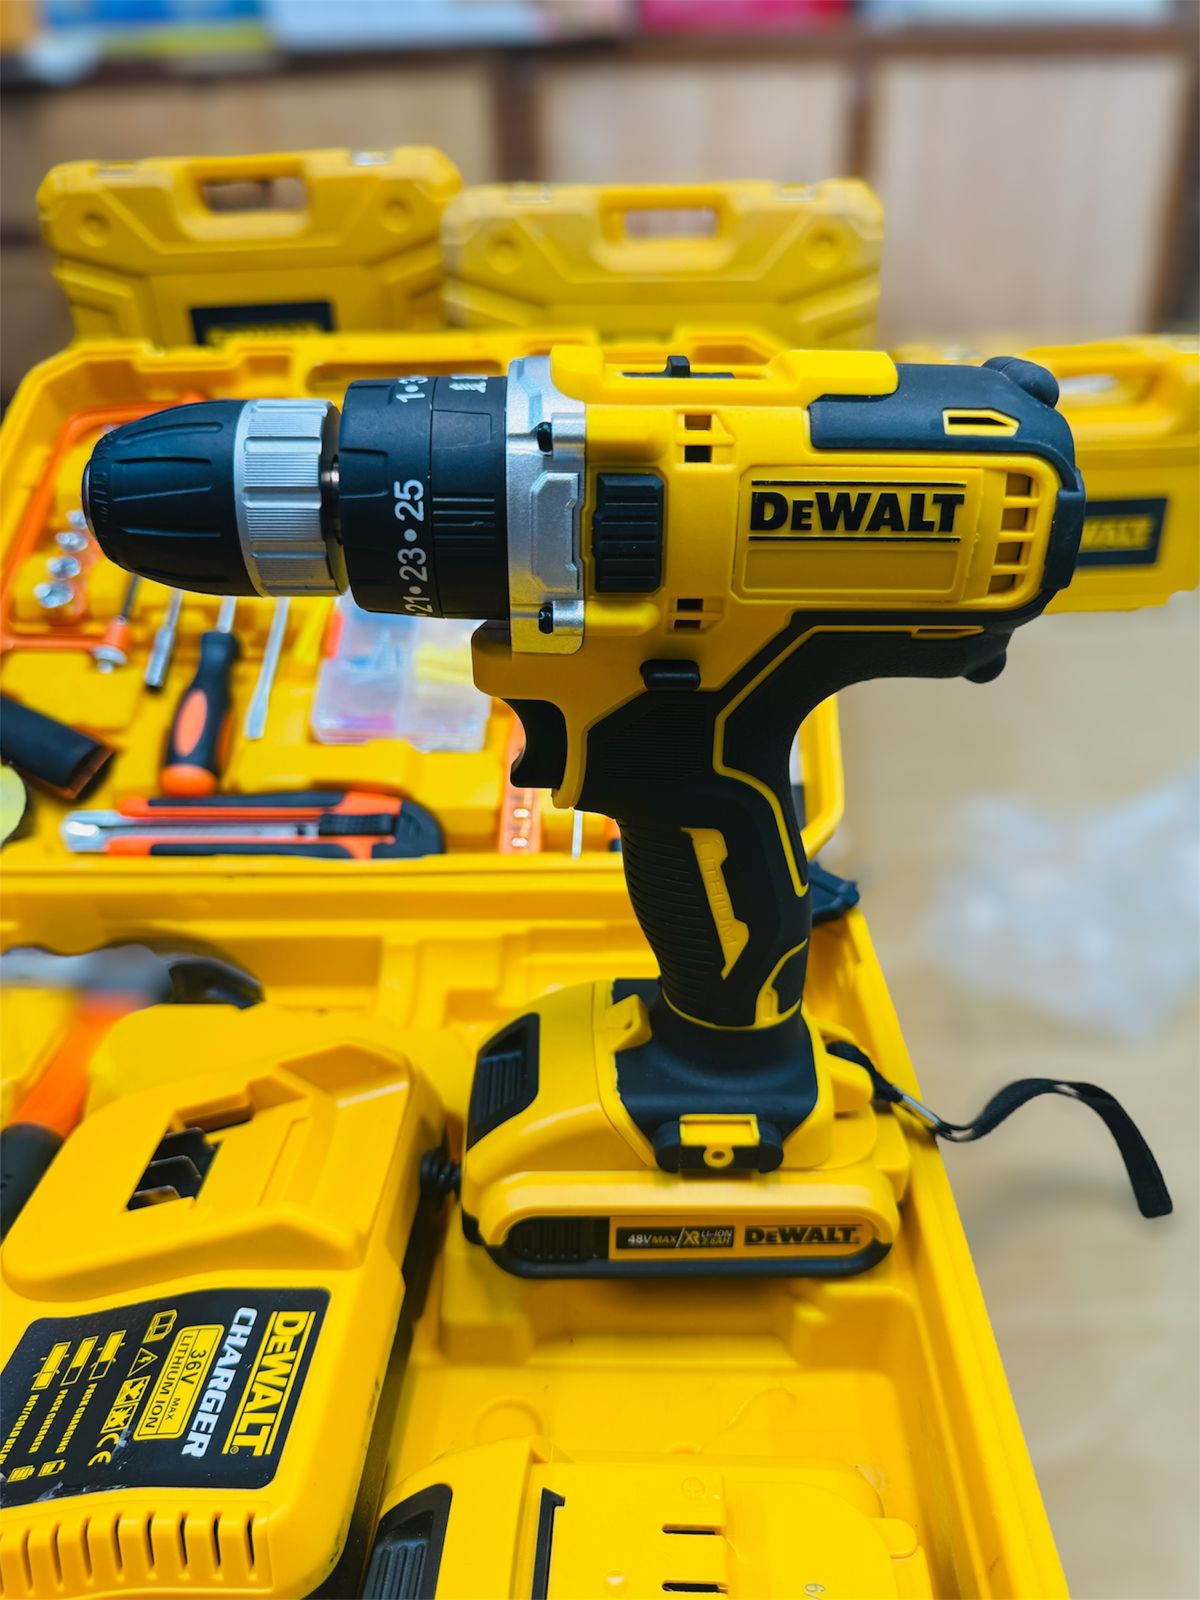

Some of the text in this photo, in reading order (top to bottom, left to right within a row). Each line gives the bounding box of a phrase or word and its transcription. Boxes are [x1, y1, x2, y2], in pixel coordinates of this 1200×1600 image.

[393, 479, 424, 521] 25
[750, 491, 965, 533] DEWALT
[397, 547, 428, 582] 23
[744, 1227, 857, 1242] DEWALT
[79, 1383, 98, 1407] PACK
[146, 1335, 193, 1428] LITHIUM ION
[165, 1350, 207, 1420] 36V MAX
[181, 1307, 257, 1458] CHARGER
[231, 1311, 310, 1457] DEWALT
